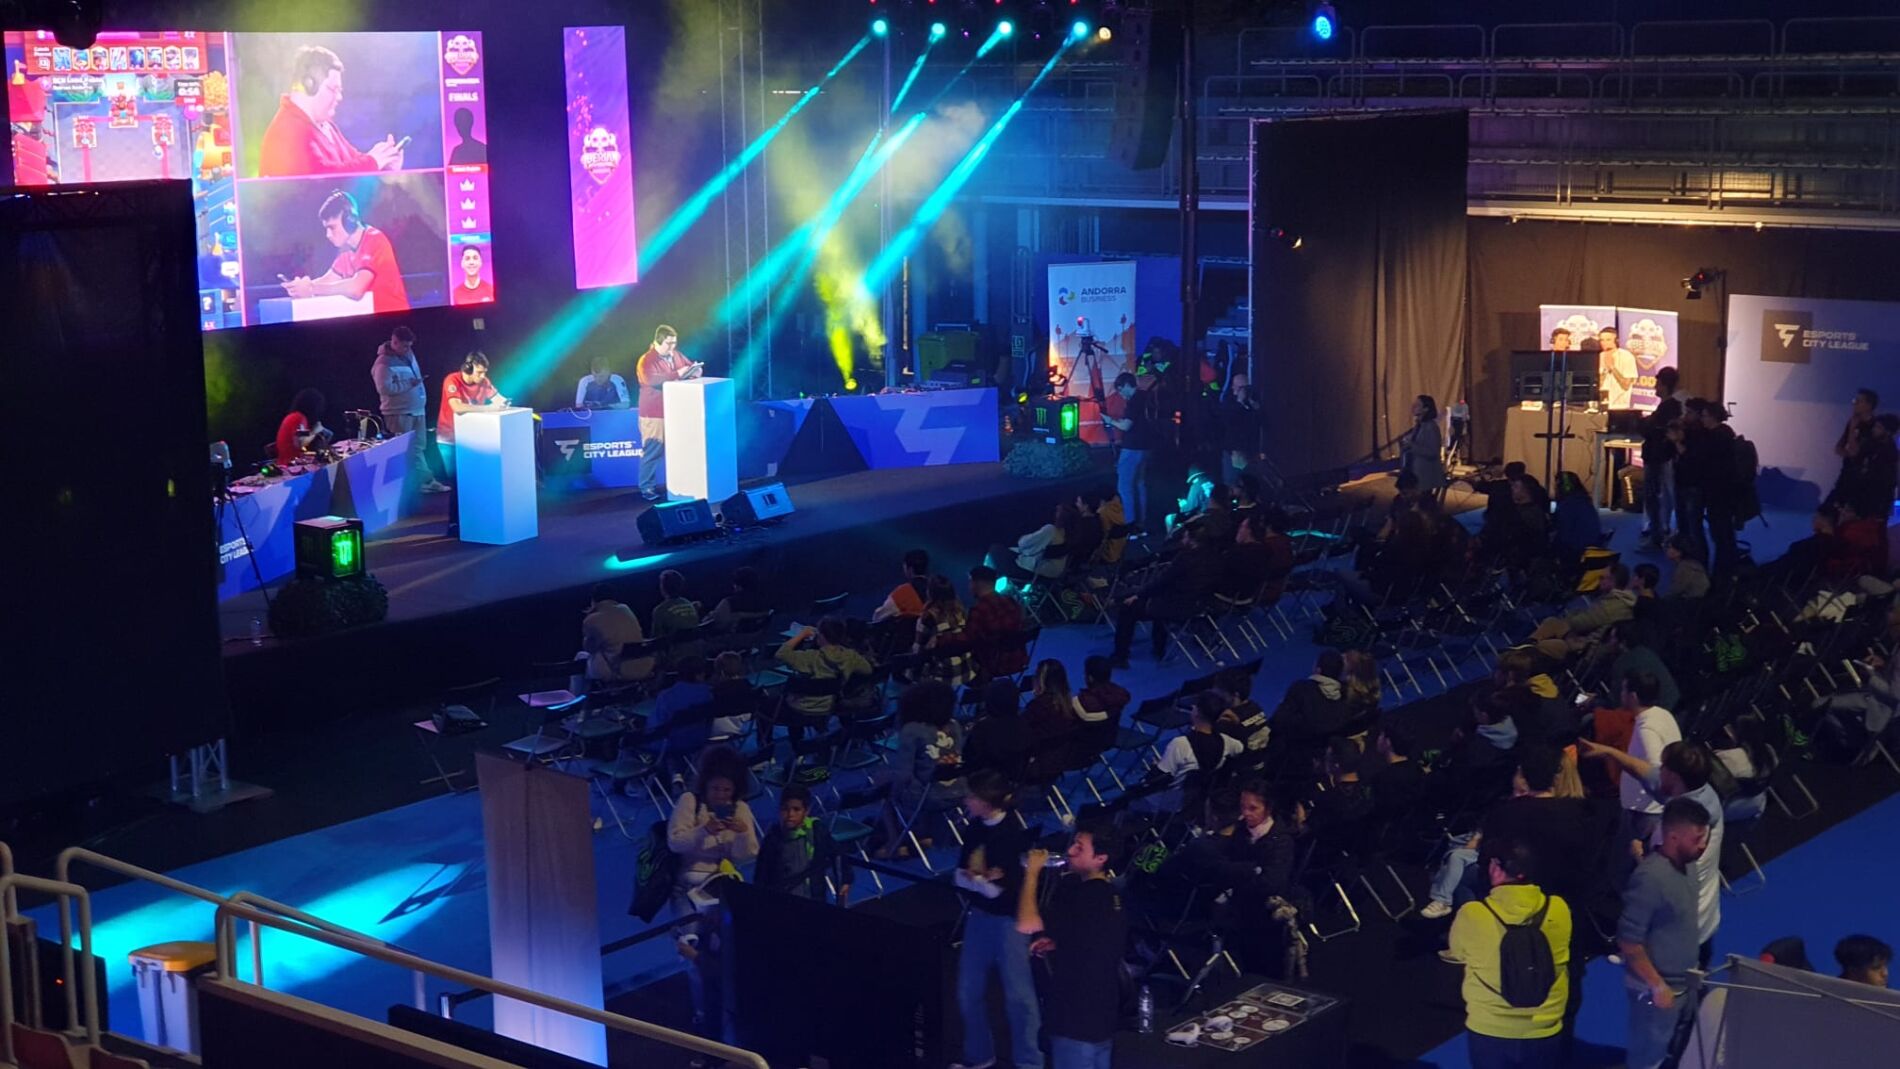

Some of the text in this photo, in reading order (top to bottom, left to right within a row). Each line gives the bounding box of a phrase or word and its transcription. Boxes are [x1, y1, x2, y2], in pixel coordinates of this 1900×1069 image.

[448, 92, 479, 102] FINALS
[1081, 286, 1127, 295] ANDORRA
[1803, 330, 1856, 340] ESPORTS
[1803, 339, 1870, 350] CITY LEAGUE
[583, 442, 632, 450] ESPORTS
[220, 551, 233, 564] CITY
